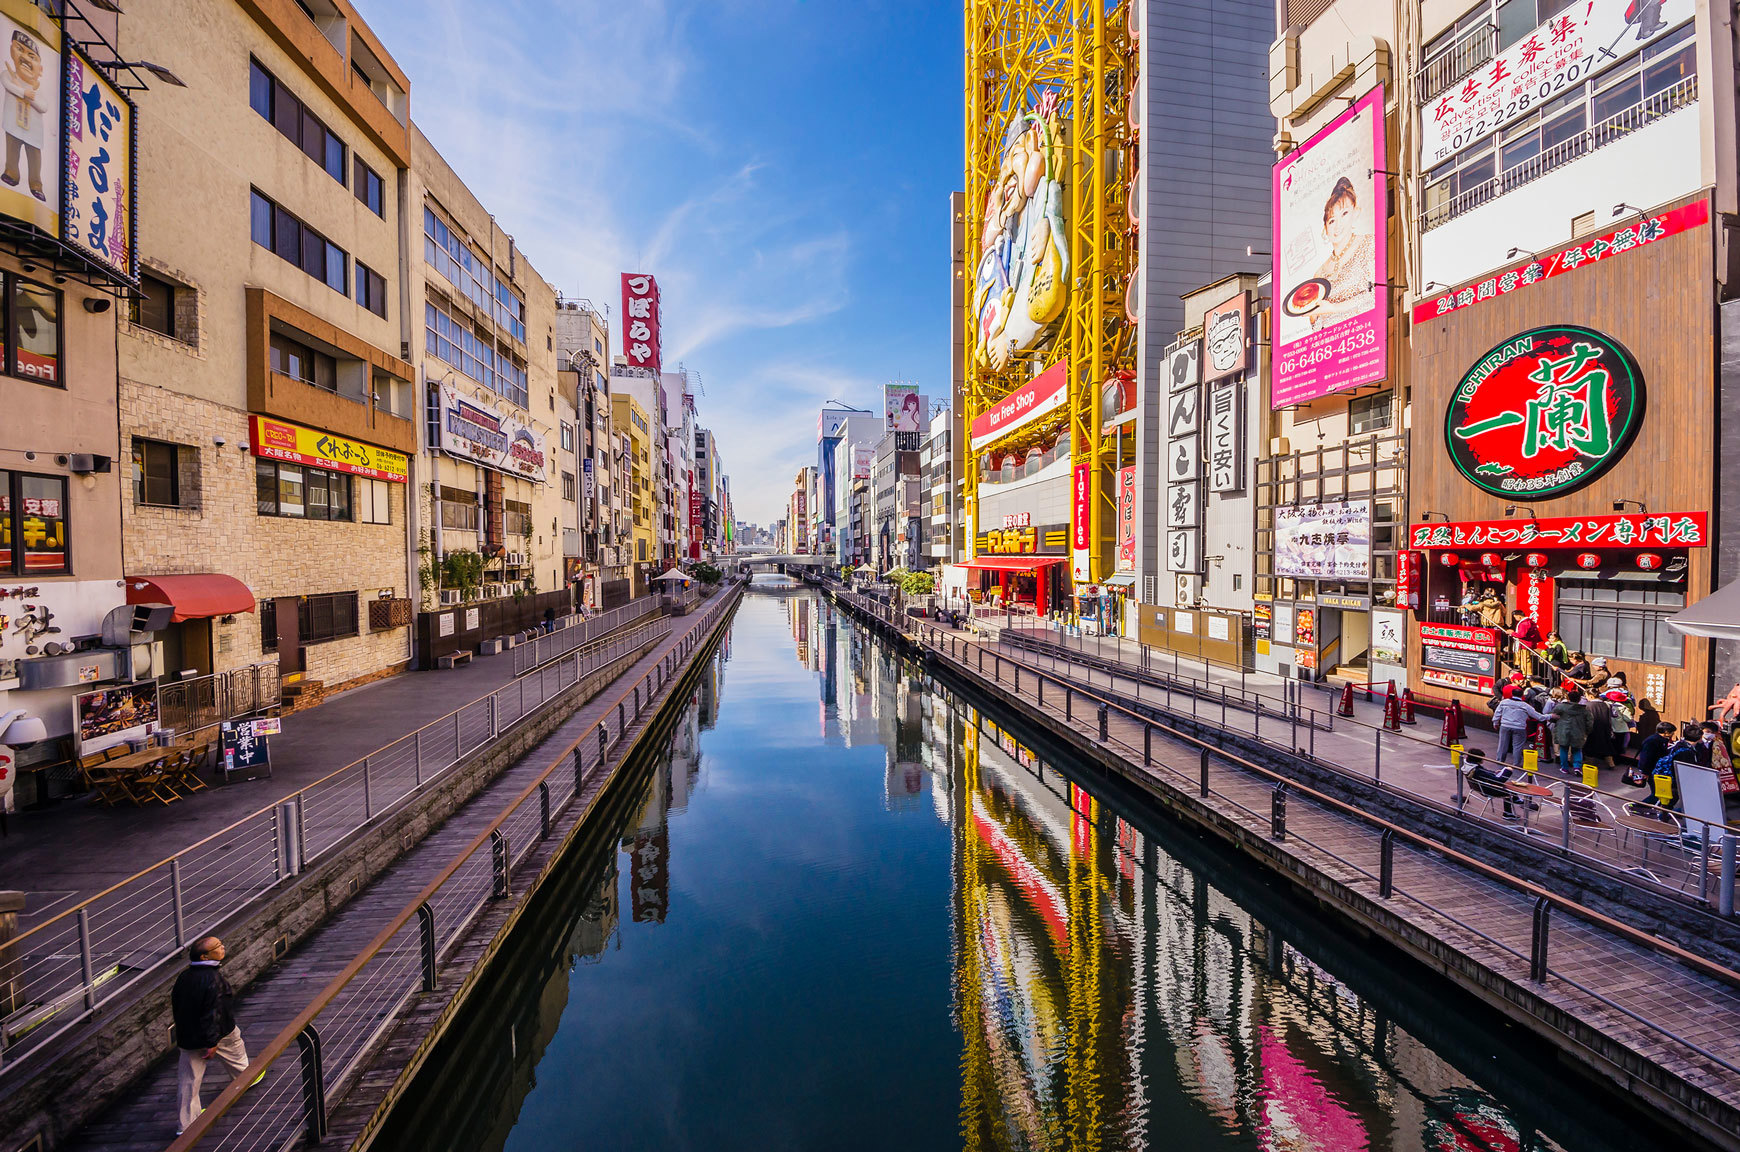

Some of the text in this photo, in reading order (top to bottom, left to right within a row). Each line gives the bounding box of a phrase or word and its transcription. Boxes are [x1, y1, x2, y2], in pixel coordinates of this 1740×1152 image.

[1440, 37, 1584, 131] Advertiser collection
[1452, 54, 1595, 149] 072-228-0207
[82, 82, 121, 258] だるま
[1280, 329, 1376, 375] 06-6468-4538
[1457, 336, 1534, 404] ICHIRAN
[989, 390, 1035, 427] Tax Free Shop
[1454, 343, 1612, 459] 一蘭
[264, 447, 302, 461] 大阪名物
[316, 435, 370, 466] くれおーる
[1213, 389, 1233, 488] 旨くて安い
[1077, 469, 1085, 501] Tax
[1501, 461, 1585, 491] 昭和35年創業
[1278, 506, 1318, 519] 大阪名物
[1413, 516, 1702, 548] 天然とんこつラーメン専門店
[237, 721, 255, 764] 営業中
